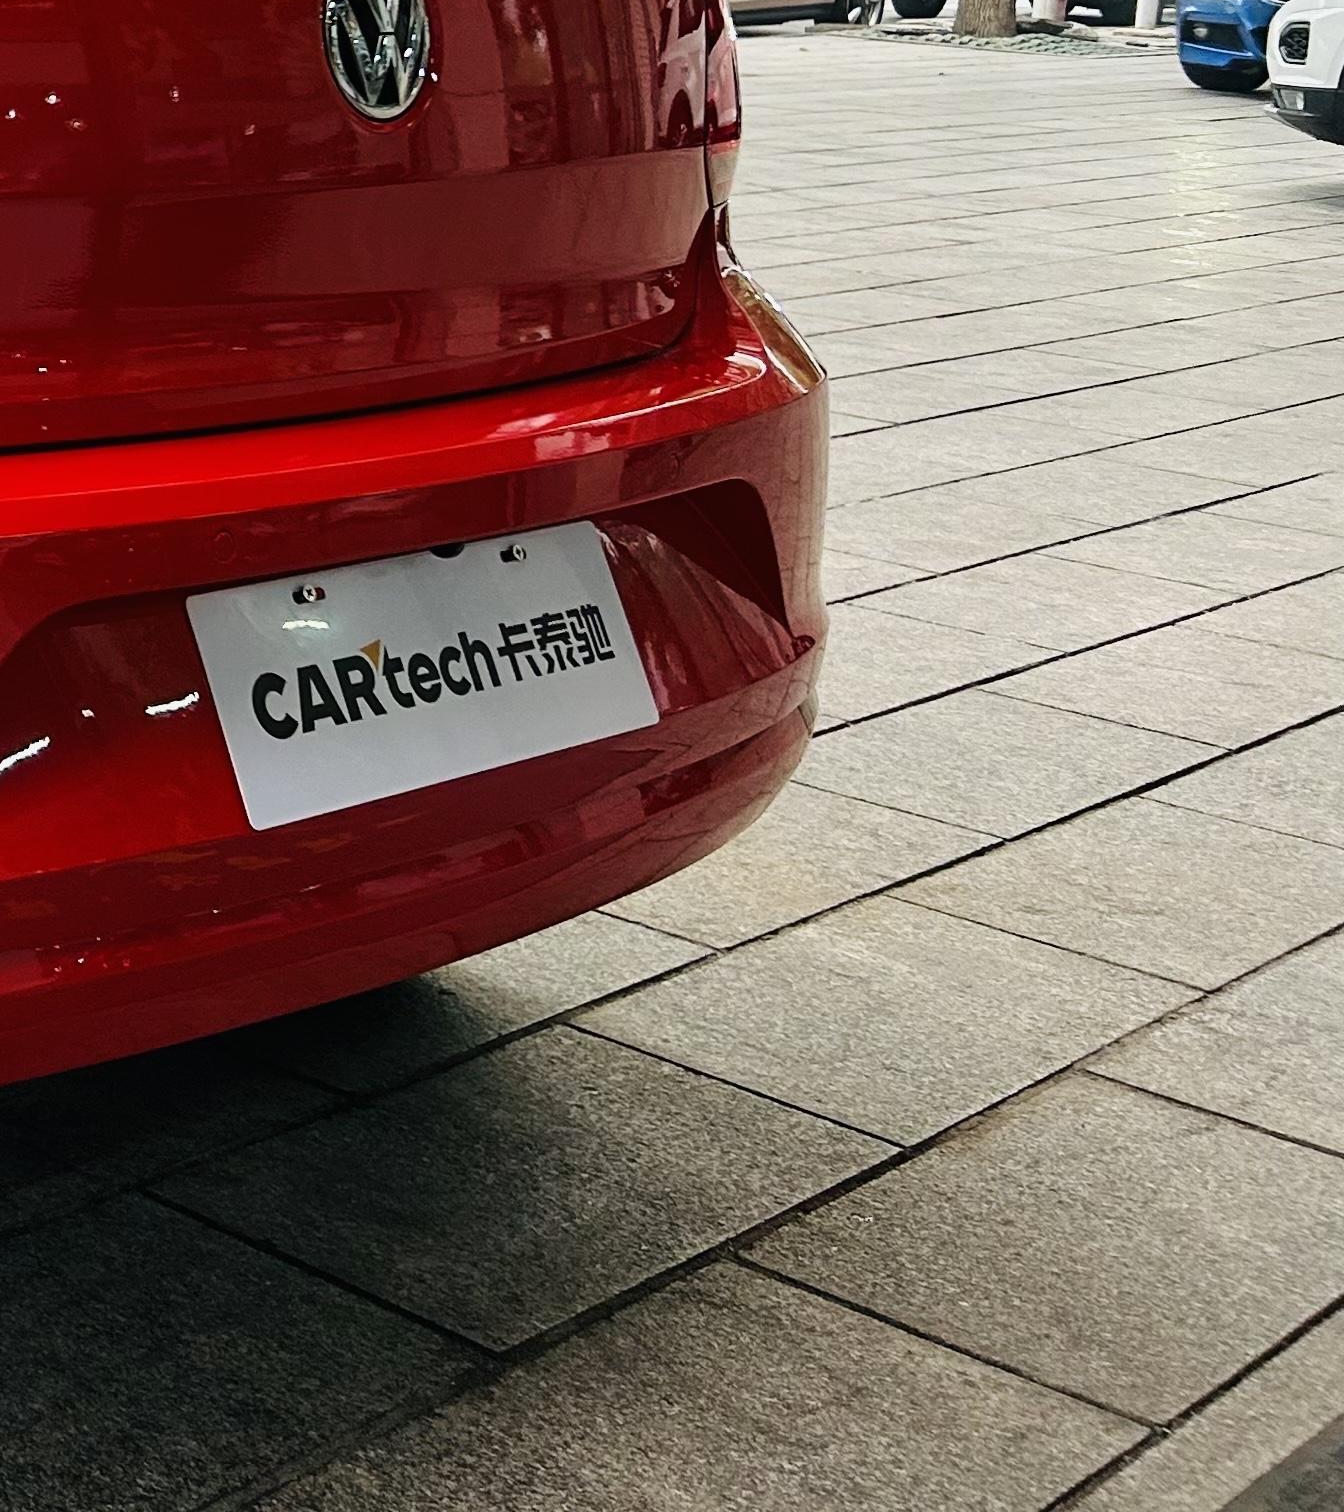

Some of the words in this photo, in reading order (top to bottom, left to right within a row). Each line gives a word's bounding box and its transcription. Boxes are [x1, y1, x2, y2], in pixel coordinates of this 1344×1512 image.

[252, 631, 501, 740] CARtech
[498, 603, 616, 682] 卡泰驰
